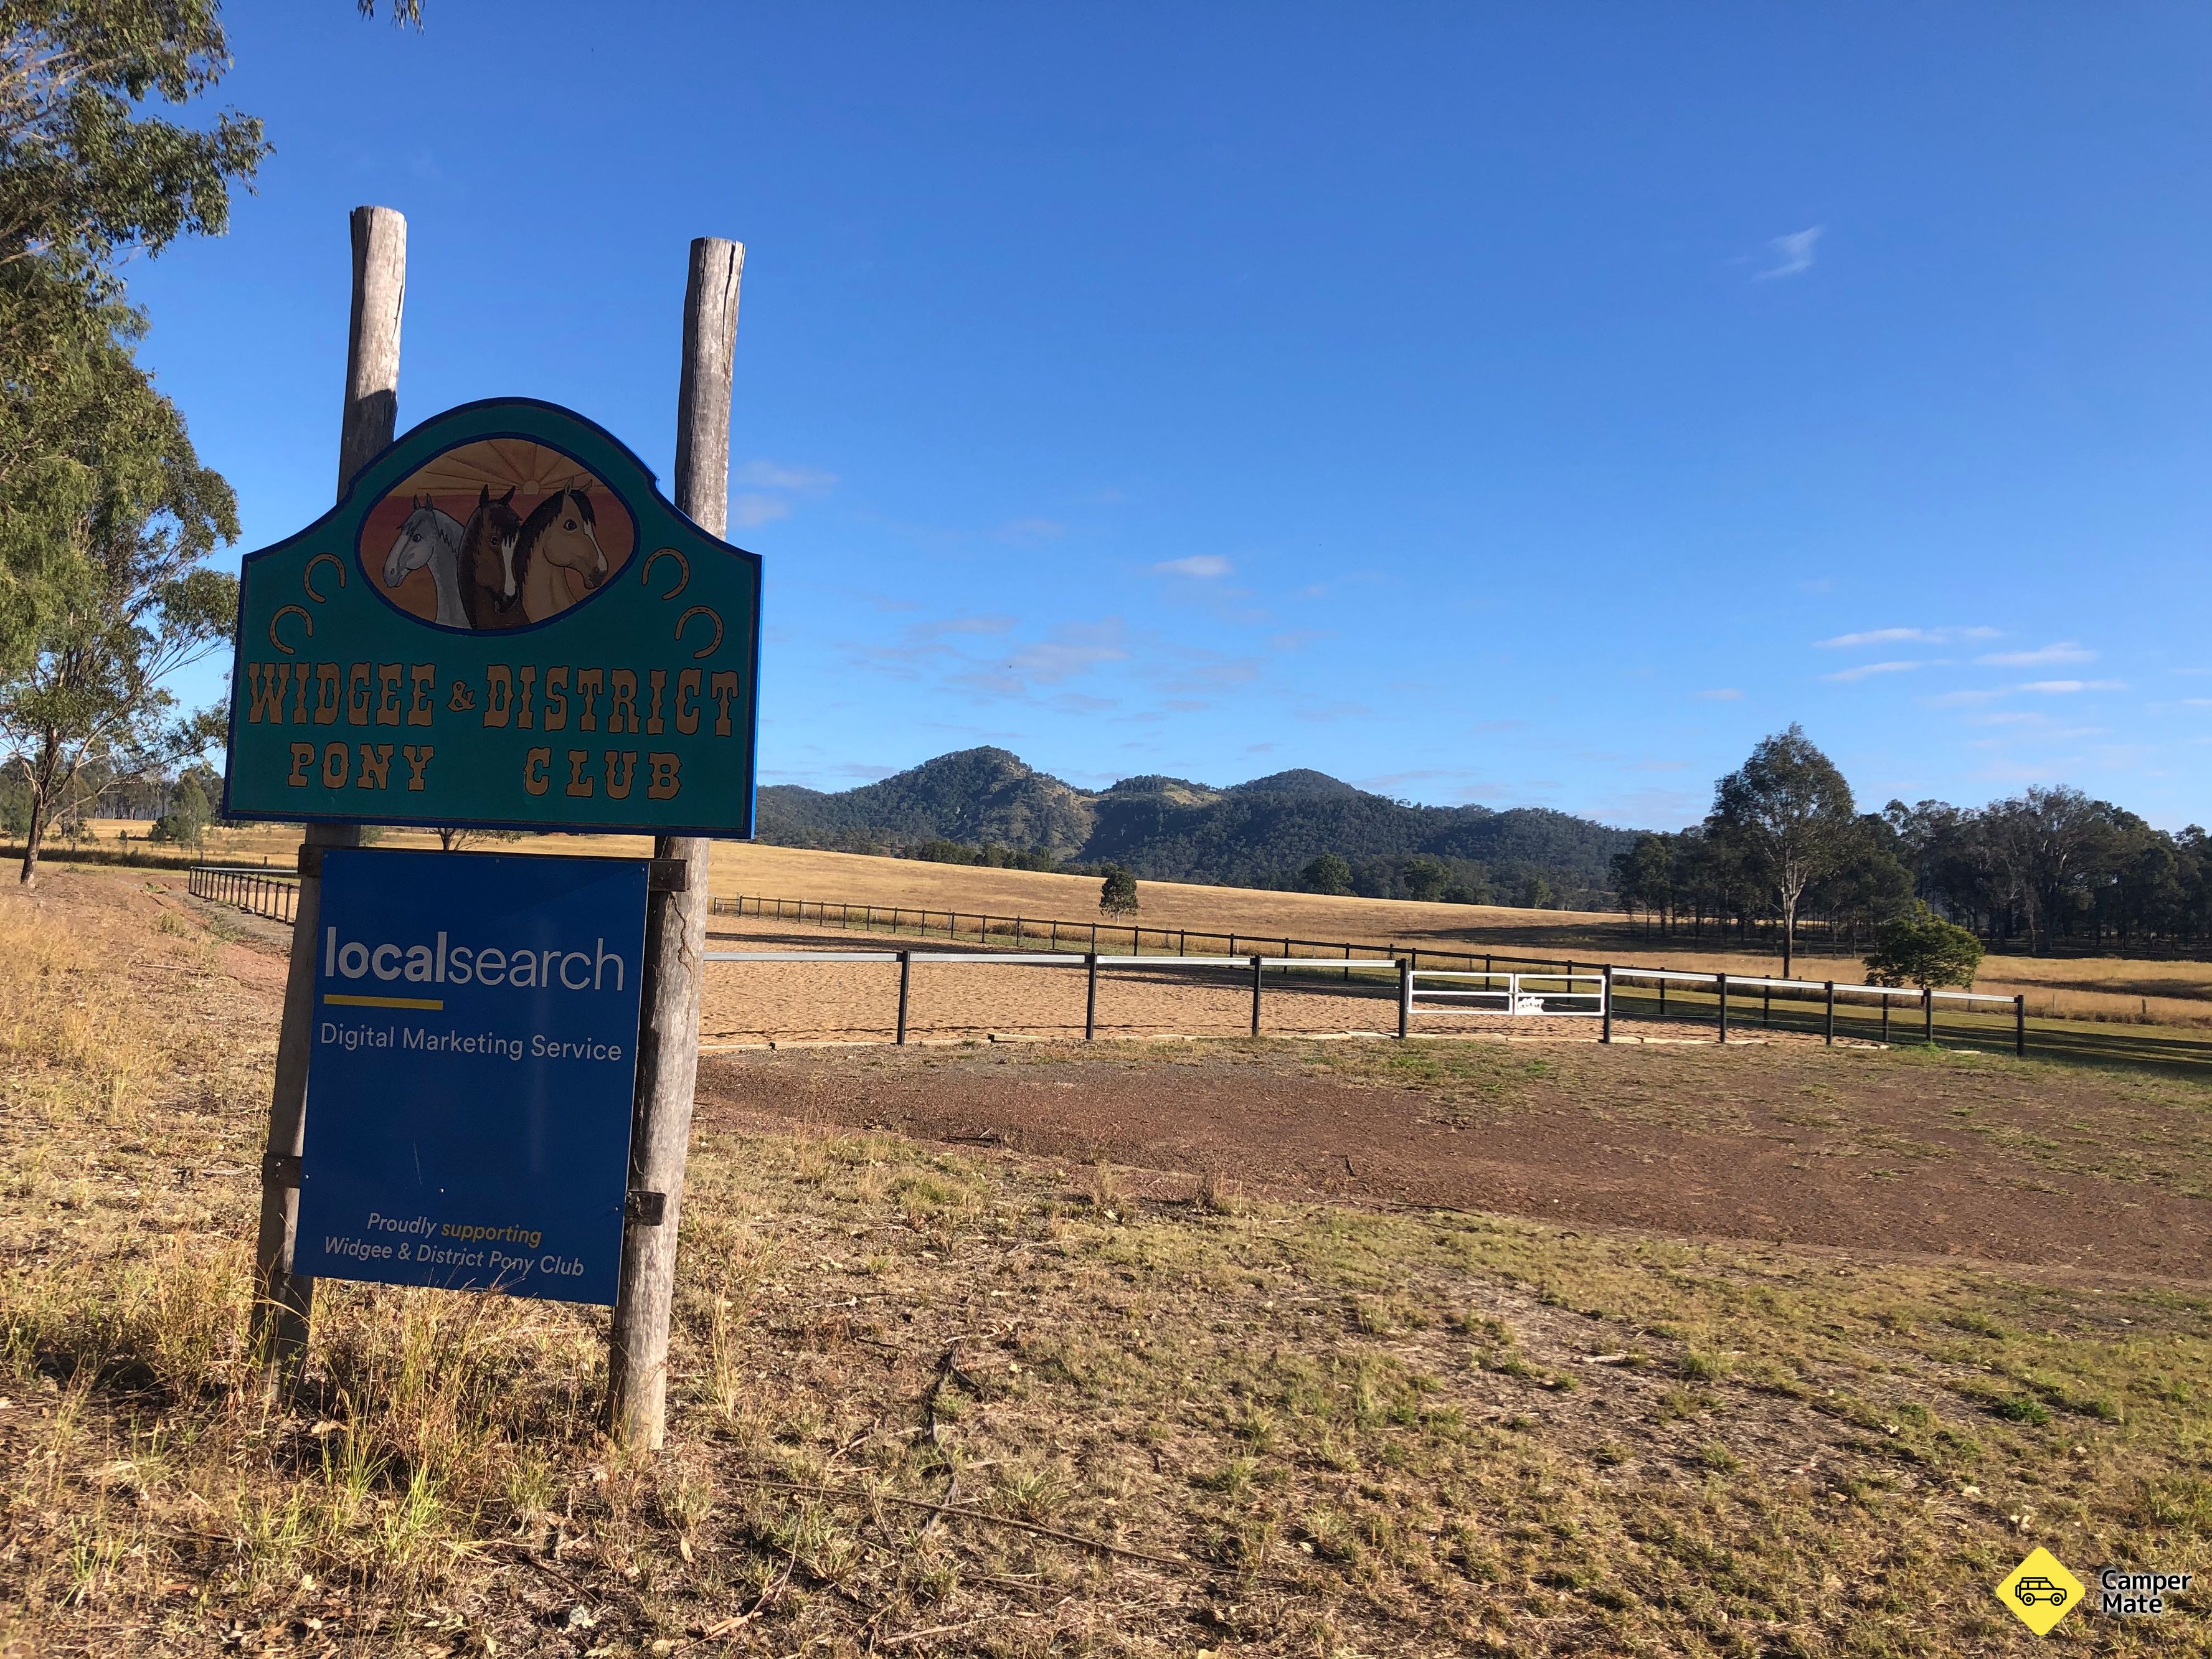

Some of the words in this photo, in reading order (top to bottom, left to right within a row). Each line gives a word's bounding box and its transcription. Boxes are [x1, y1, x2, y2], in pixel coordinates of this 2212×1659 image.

[248, 661, 438, 726] WIDGEE
[447, 679, 477, 712] &
[483, 663, 739, 737] DISTRICT
[287, 740, 435, 792] PONY
[524, 747, 683, 800] CLUB
[324, 926, 623, 991] localsearch
[320, 1023, 395, 1051] Digital
[402, 1028, 523, 1061] Marketing
[531, 1034, 622, 1061] Service
[367, 1212, 437, 1238] Proudly
[441, 1219, 542, 1248] supporting
[325, 1236, 393, 1262] Widgee
[397, 1243, 411, 1261] &
[416, 1244, 484, 1269] District
[489, 1250, 534, 1275] Pony
[539, 1254, 585, 1277] Club
